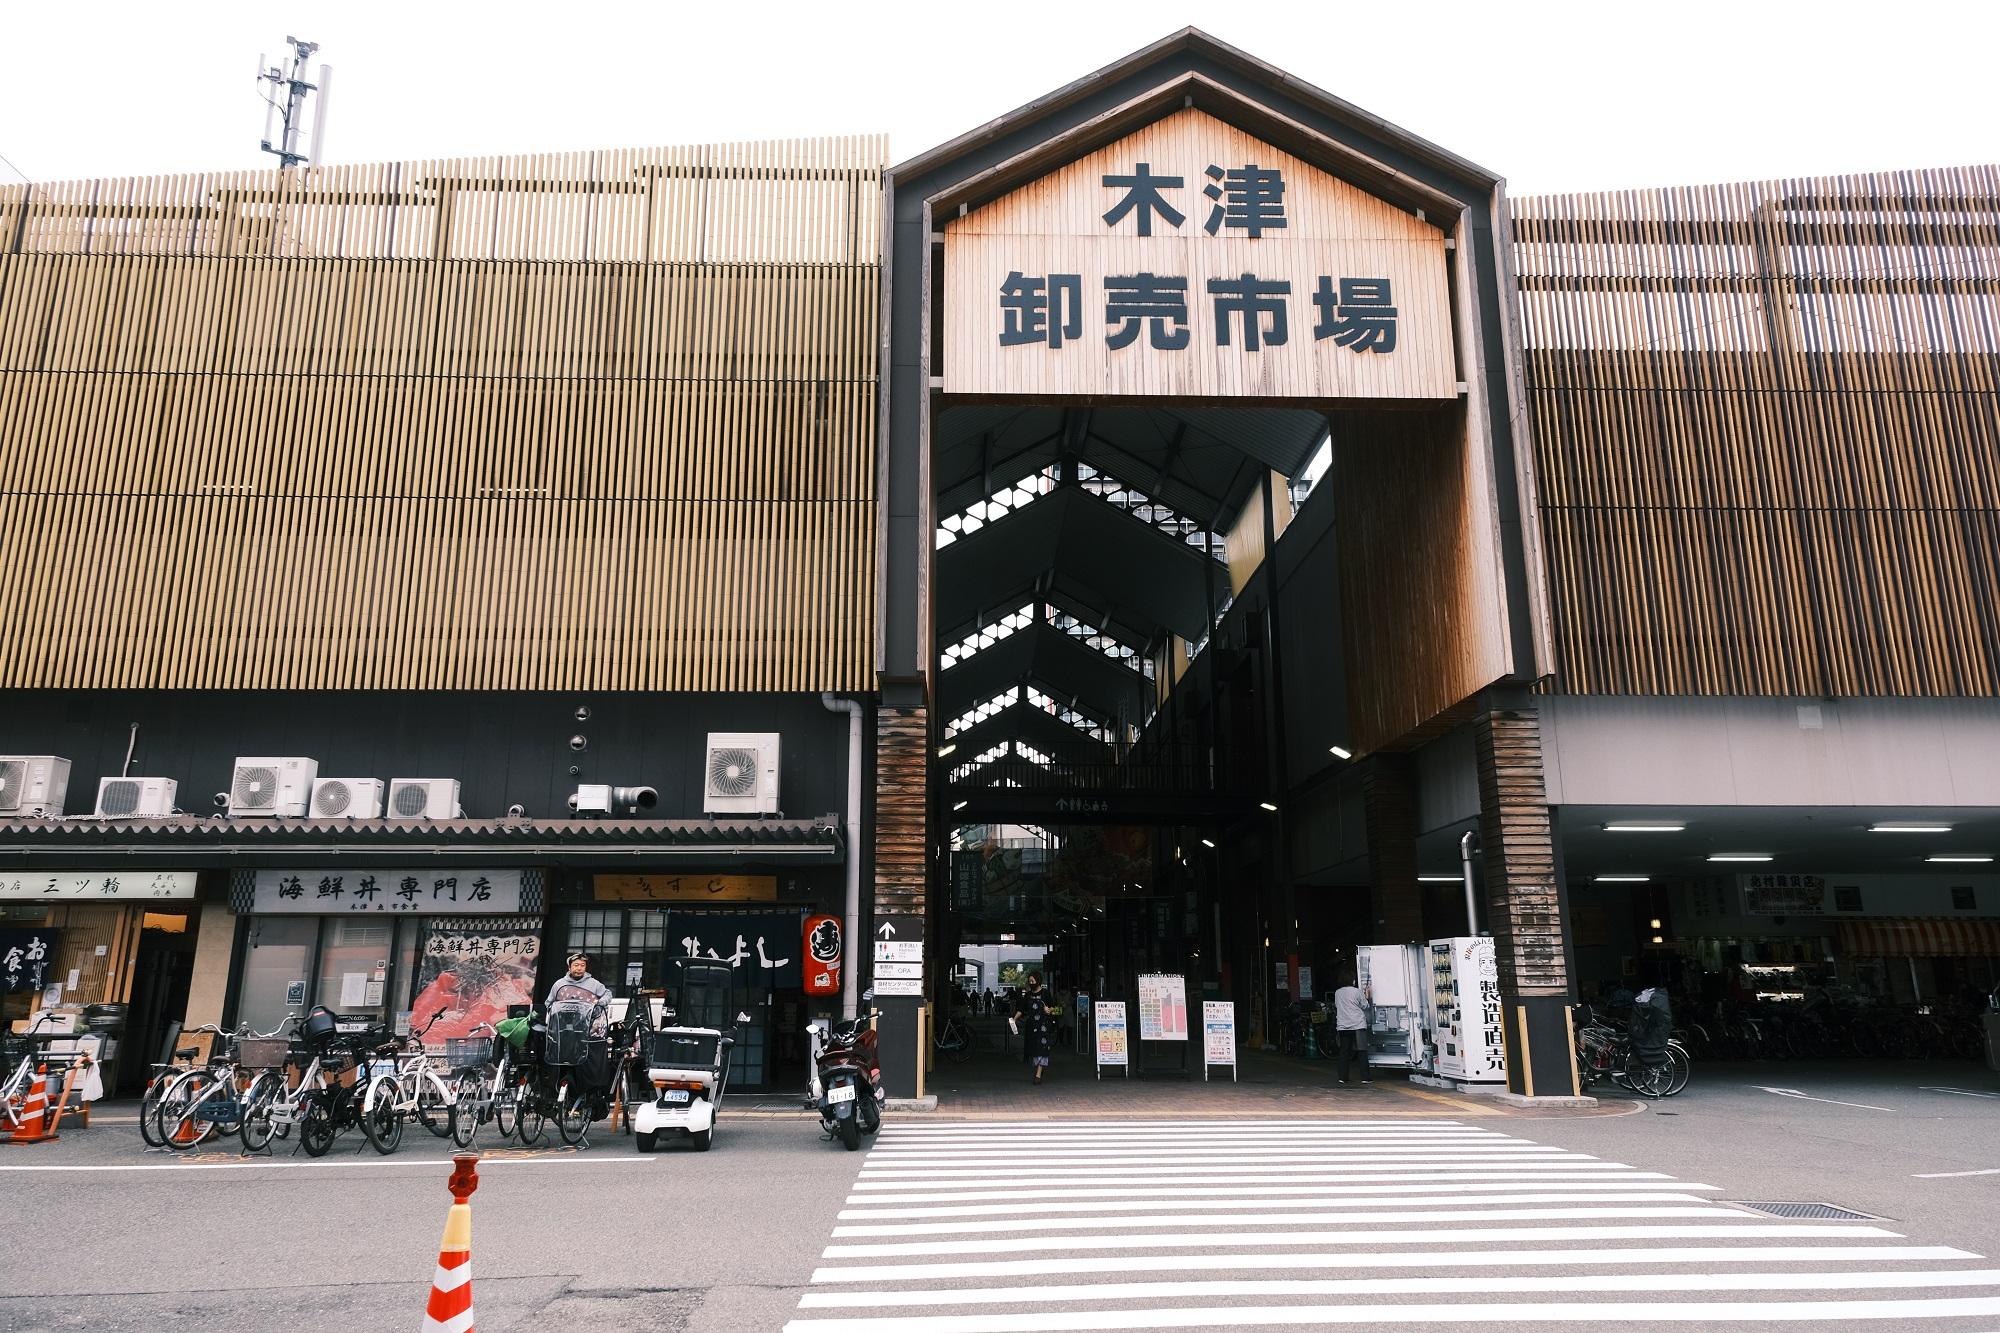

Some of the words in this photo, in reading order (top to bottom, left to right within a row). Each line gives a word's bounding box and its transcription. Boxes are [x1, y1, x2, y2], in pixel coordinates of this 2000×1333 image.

[1102, 162, 1288, 239] 木津
[999, 271, 1398, 354] 卸売市場
[43, 877, 121, 894] 三ツ輪
[278, 875, 493, 902] 海鮮丼専門店
[428, 938, 536, 956] 海鮮丼専門店
